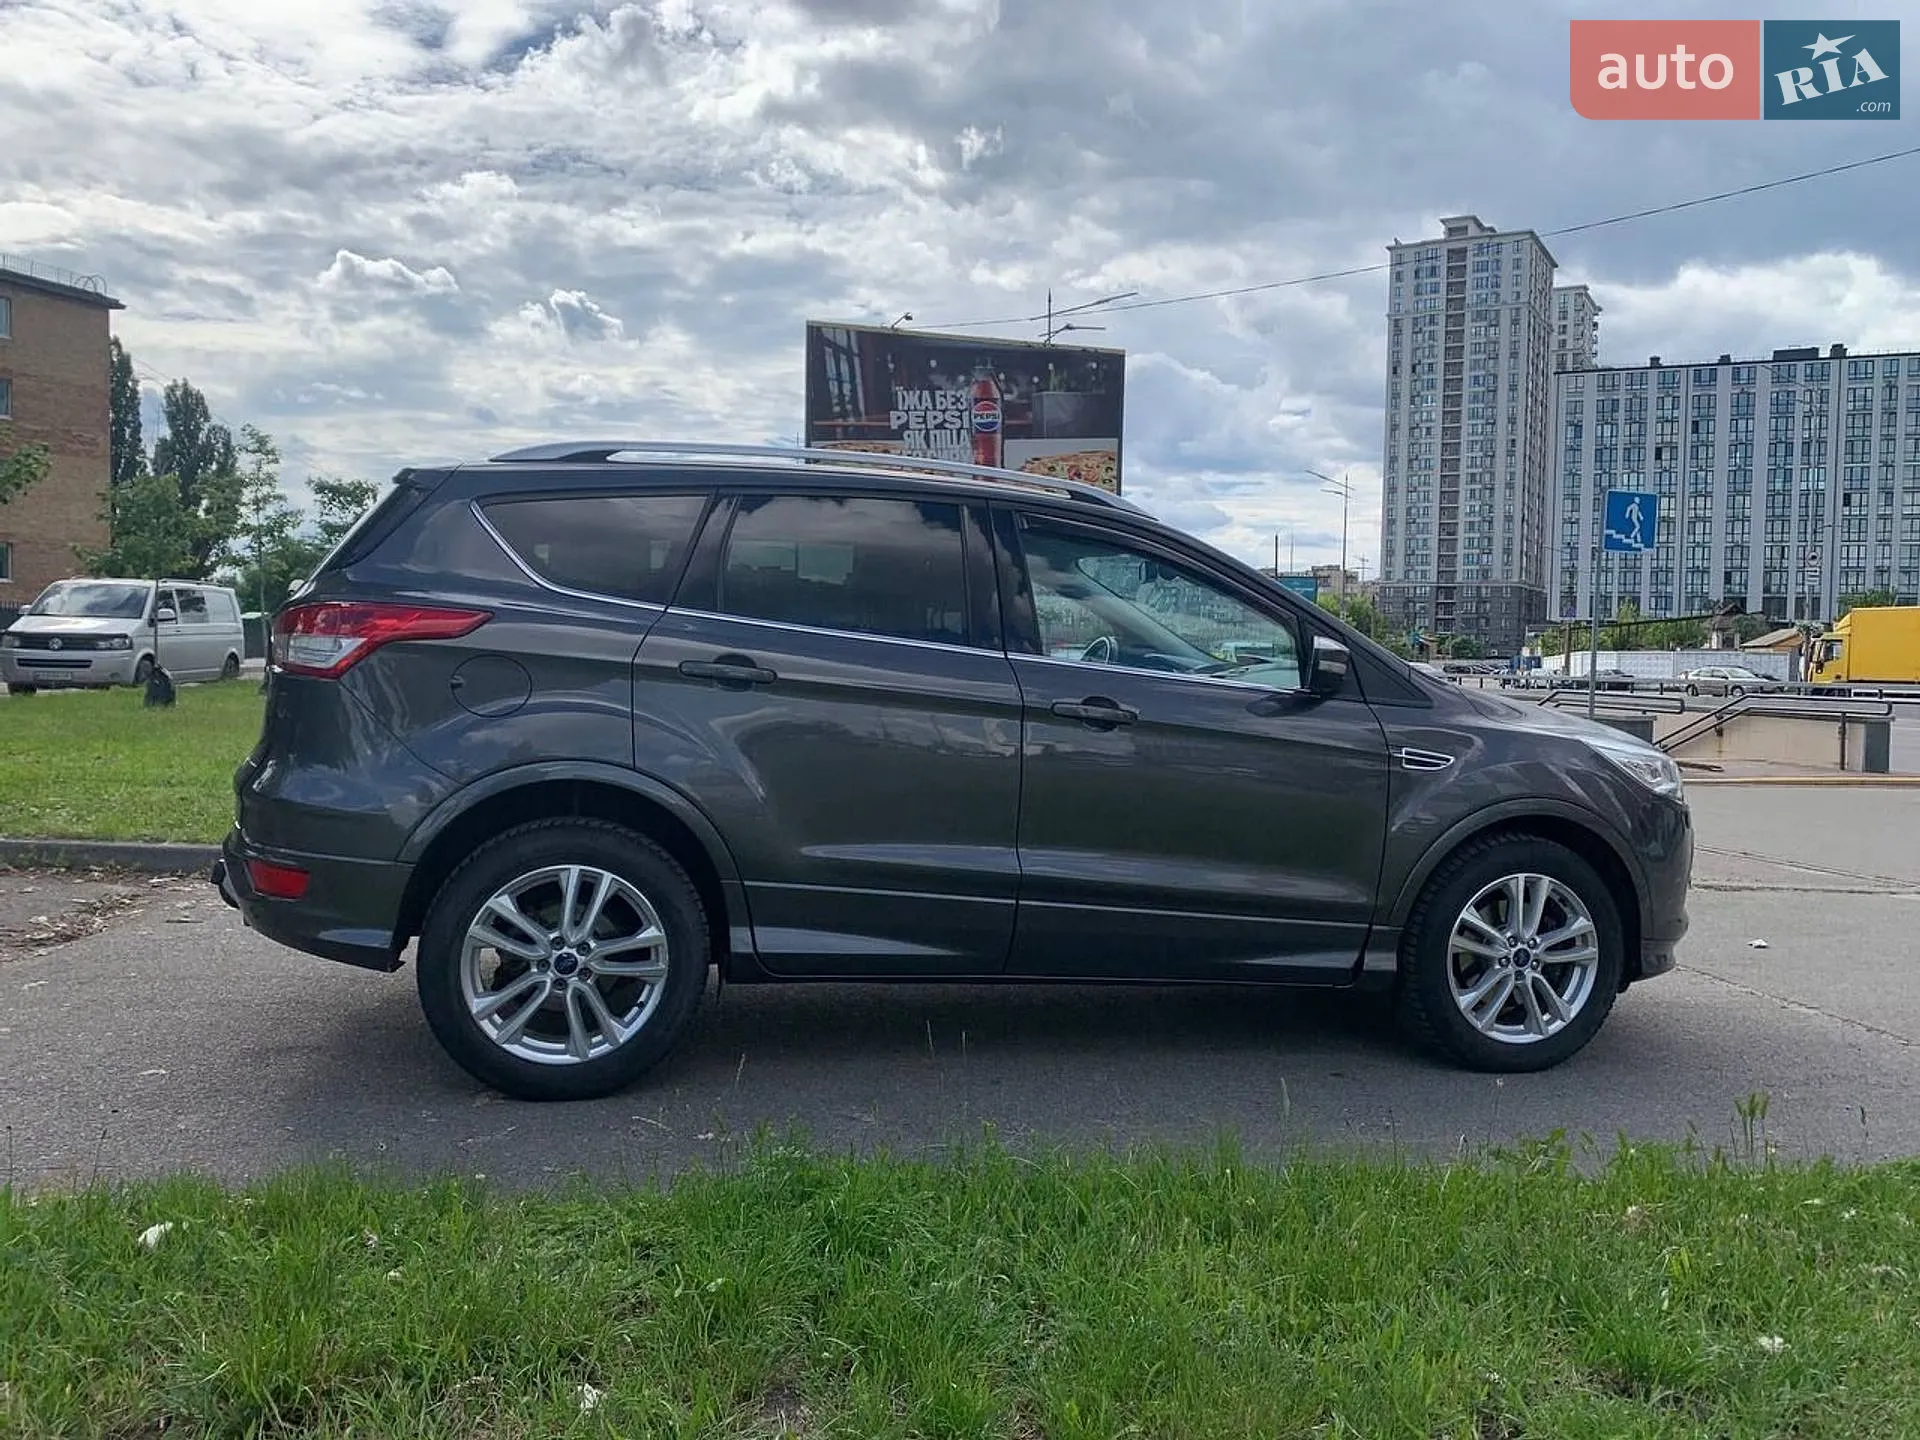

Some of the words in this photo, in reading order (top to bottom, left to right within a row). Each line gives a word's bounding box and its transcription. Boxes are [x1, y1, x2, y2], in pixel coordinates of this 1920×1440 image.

[935, 388, 968, 411] БЕЗ
[889, 410, 970, 429] PEPSI
[903, 429, 927, 449] ЯК
